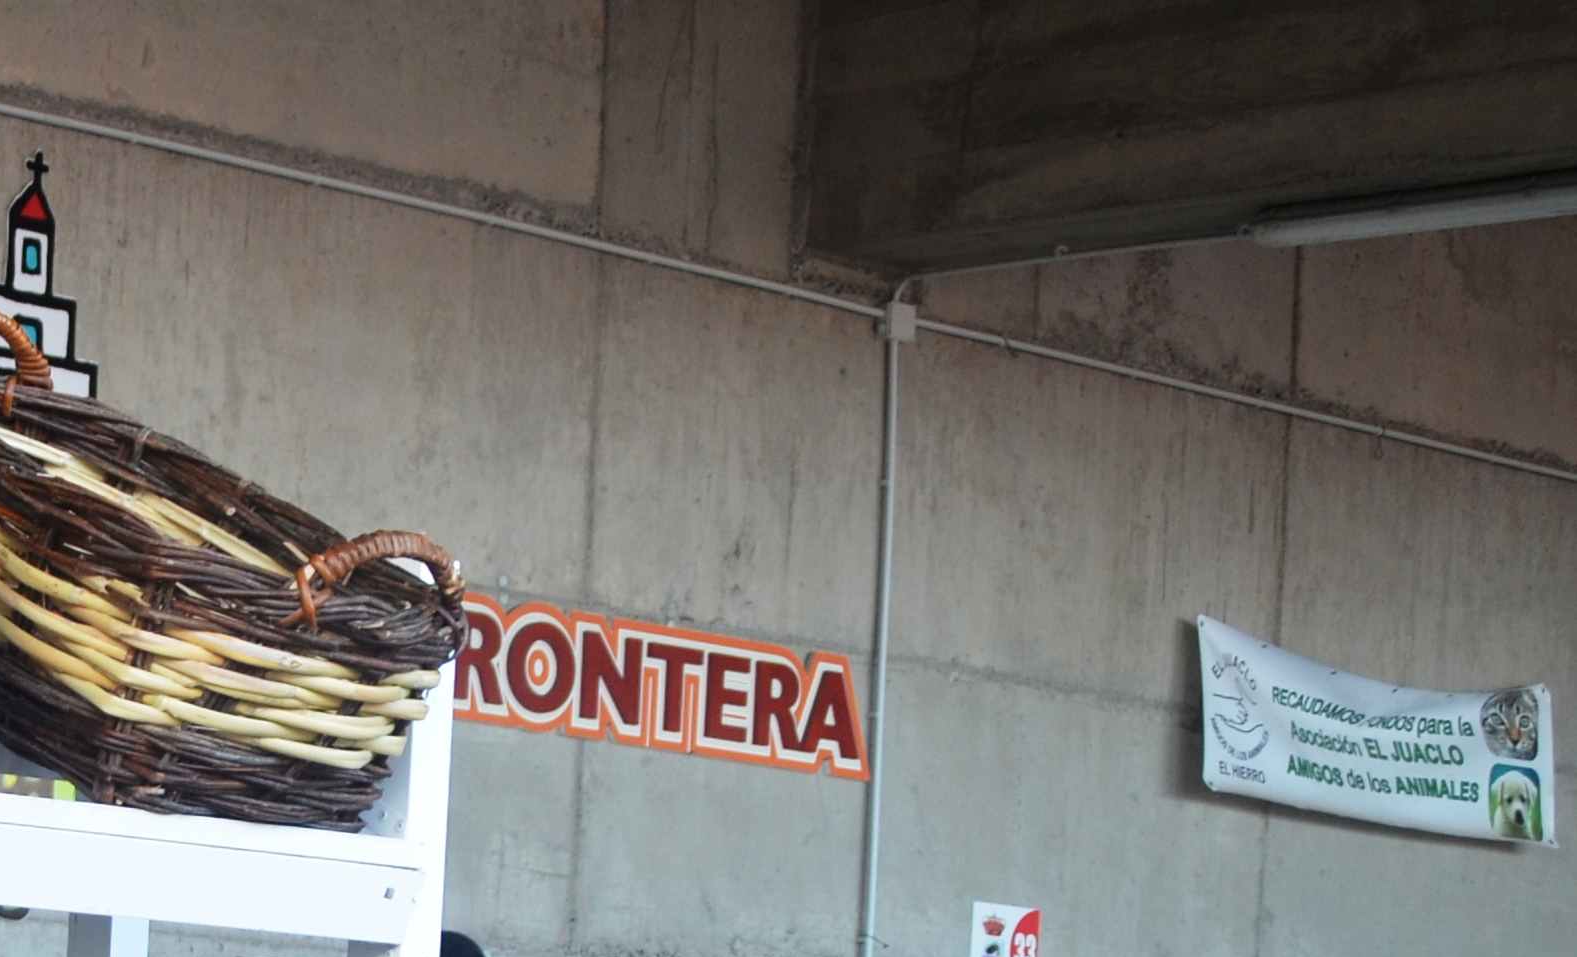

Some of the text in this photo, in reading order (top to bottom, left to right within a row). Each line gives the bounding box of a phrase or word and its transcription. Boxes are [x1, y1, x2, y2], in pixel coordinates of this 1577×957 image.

[1271, 685, 1365, 726] RECAUDAMOS
[1416, 716, 1453, 738] para
[1458, 715, 1475, 737] la
[1290, 719, 1464, 766] Asociación EL JUACLO
[1286, 753, 1480, 803] AMIGOS de los ANIMALES
